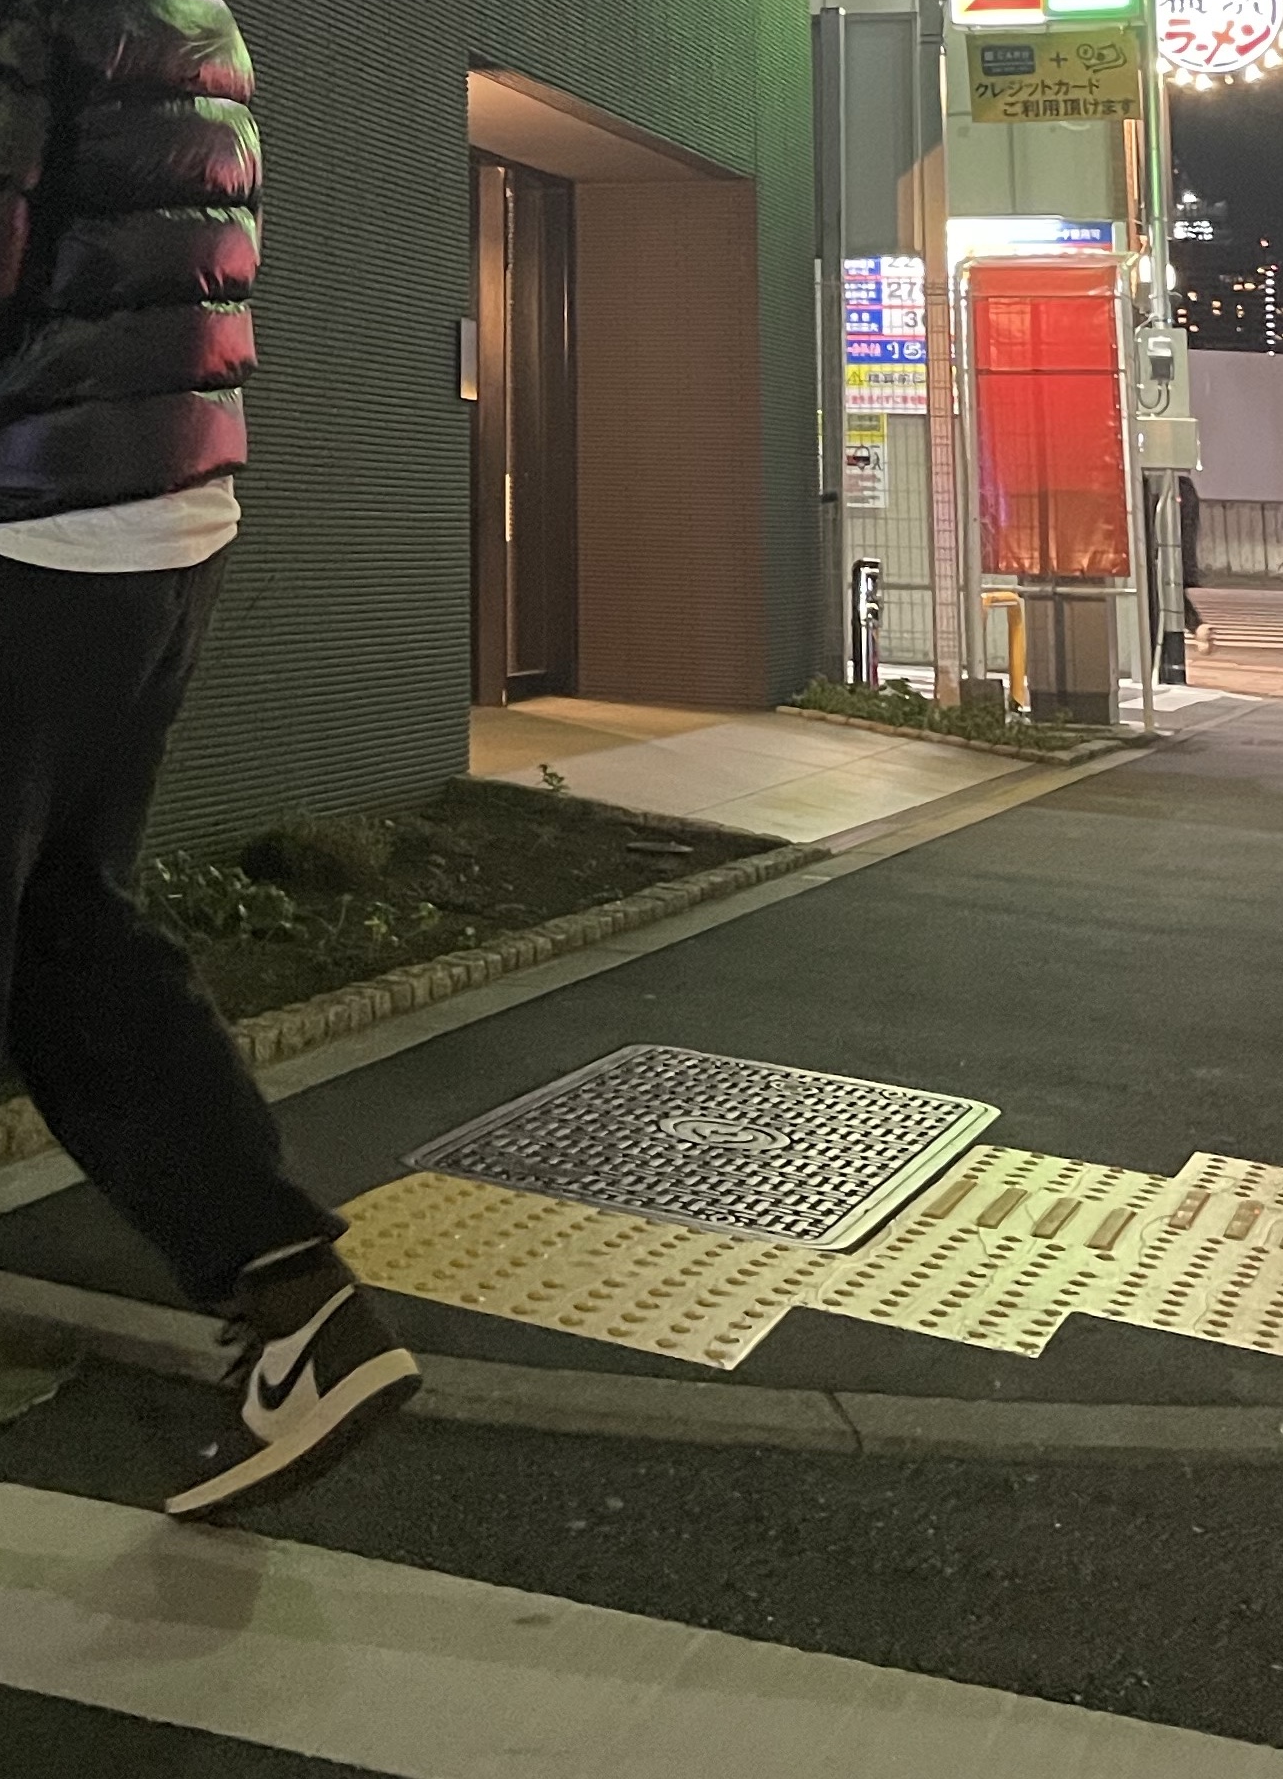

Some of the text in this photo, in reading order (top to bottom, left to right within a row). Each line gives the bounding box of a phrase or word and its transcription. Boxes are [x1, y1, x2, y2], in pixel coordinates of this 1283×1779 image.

[1164, 18, 1271, 66] ラーメン
[974, 77, 1101, 99] クレジットカード
[1002, 98, 1136, 118] ご利用頂けます
